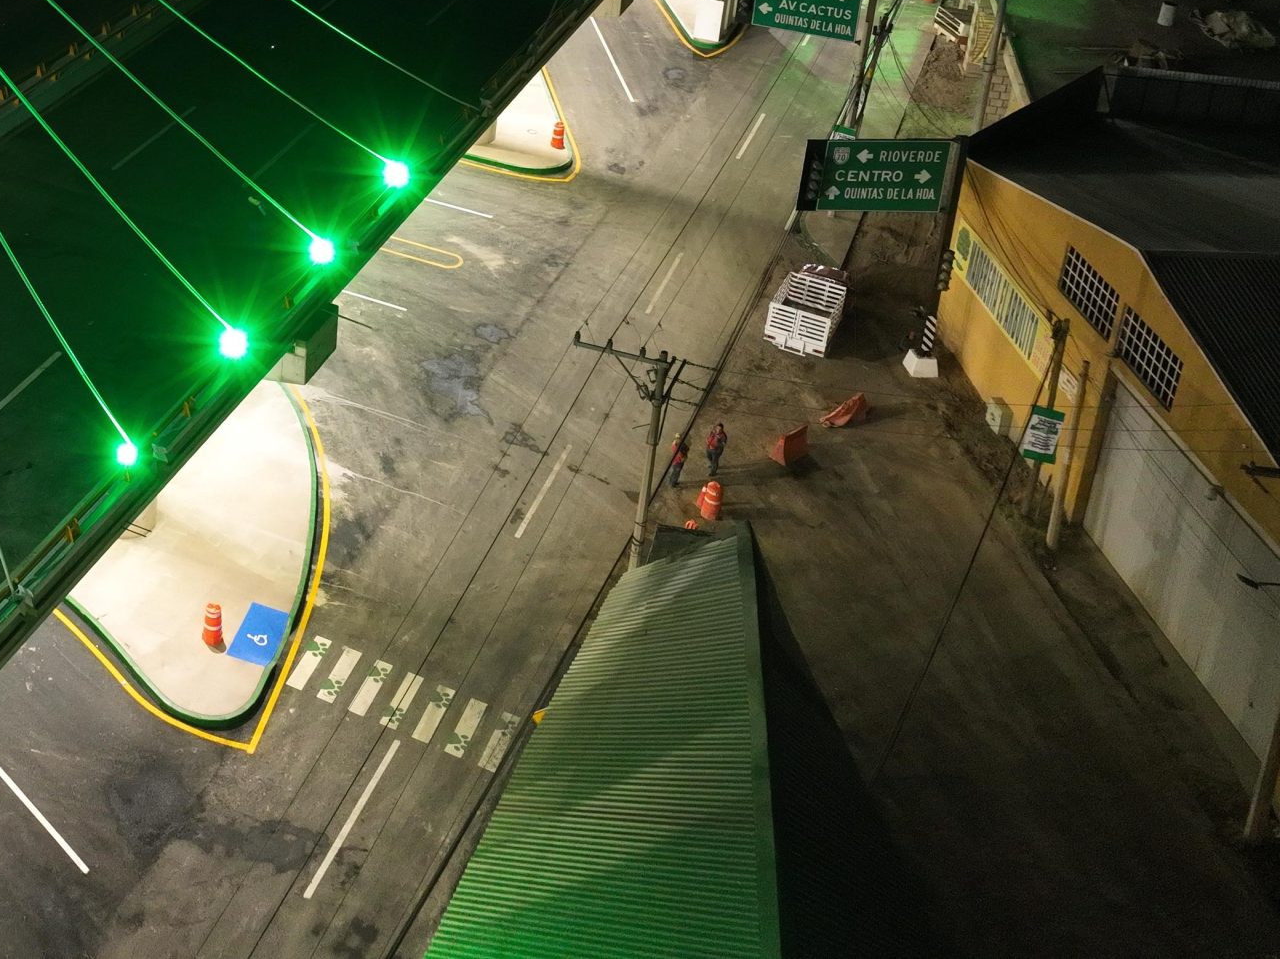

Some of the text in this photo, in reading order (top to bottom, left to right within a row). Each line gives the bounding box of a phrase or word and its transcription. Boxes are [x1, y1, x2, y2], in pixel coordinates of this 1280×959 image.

[799, 2, 853, 20] CACTUS
[774, 13, 809, 28] QUINTAS
[810, 19, 821, 31] DE
[822, 22, 833, 33] LA
[879, 150, 943, 163] RIOVERDE
[835, 169, 904, 182] CENTRO
[844, 187, 884, 200] QUINTAS
[887, 188, 899, 200] DE
[901, 188, 914, 200] LA
